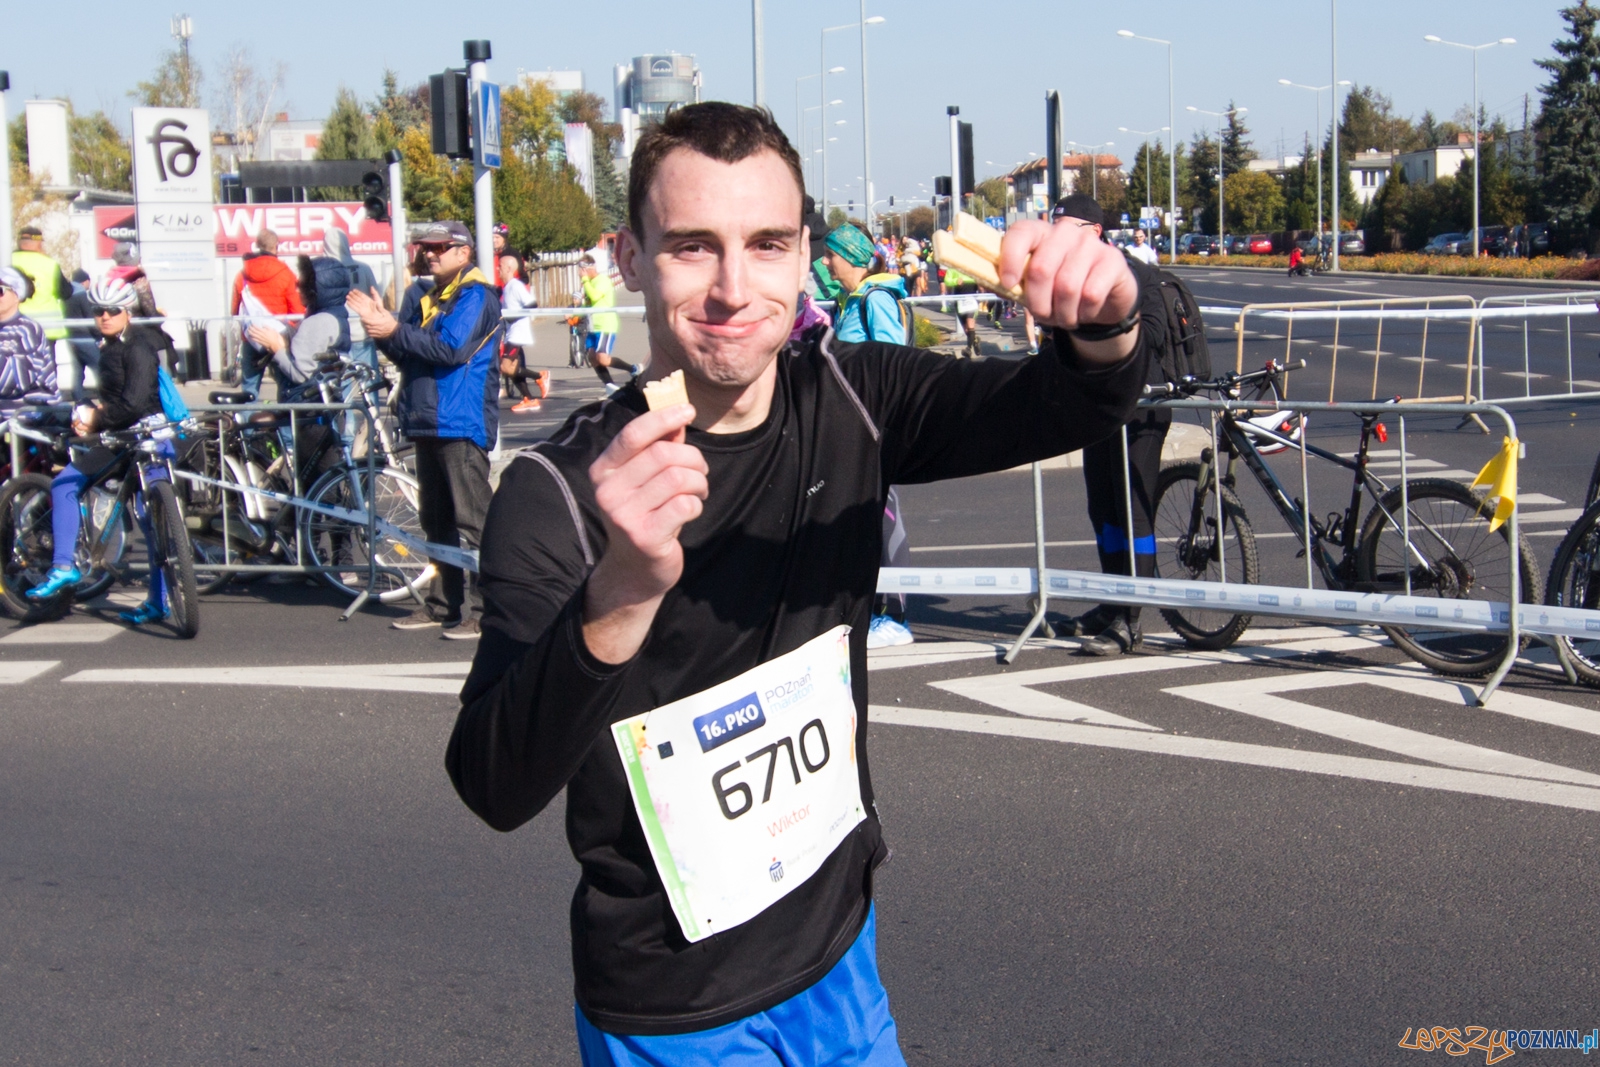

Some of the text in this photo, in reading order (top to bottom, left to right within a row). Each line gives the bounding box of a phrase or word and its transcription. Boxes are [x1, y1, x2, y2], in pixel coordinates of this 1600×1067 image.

[152, 213, 203, 226] KINO
[700, 704, 759, 741] 16.PKO
[712, 718, 830, 820] 6710
[767, 803, 810, 837] Wiktor
